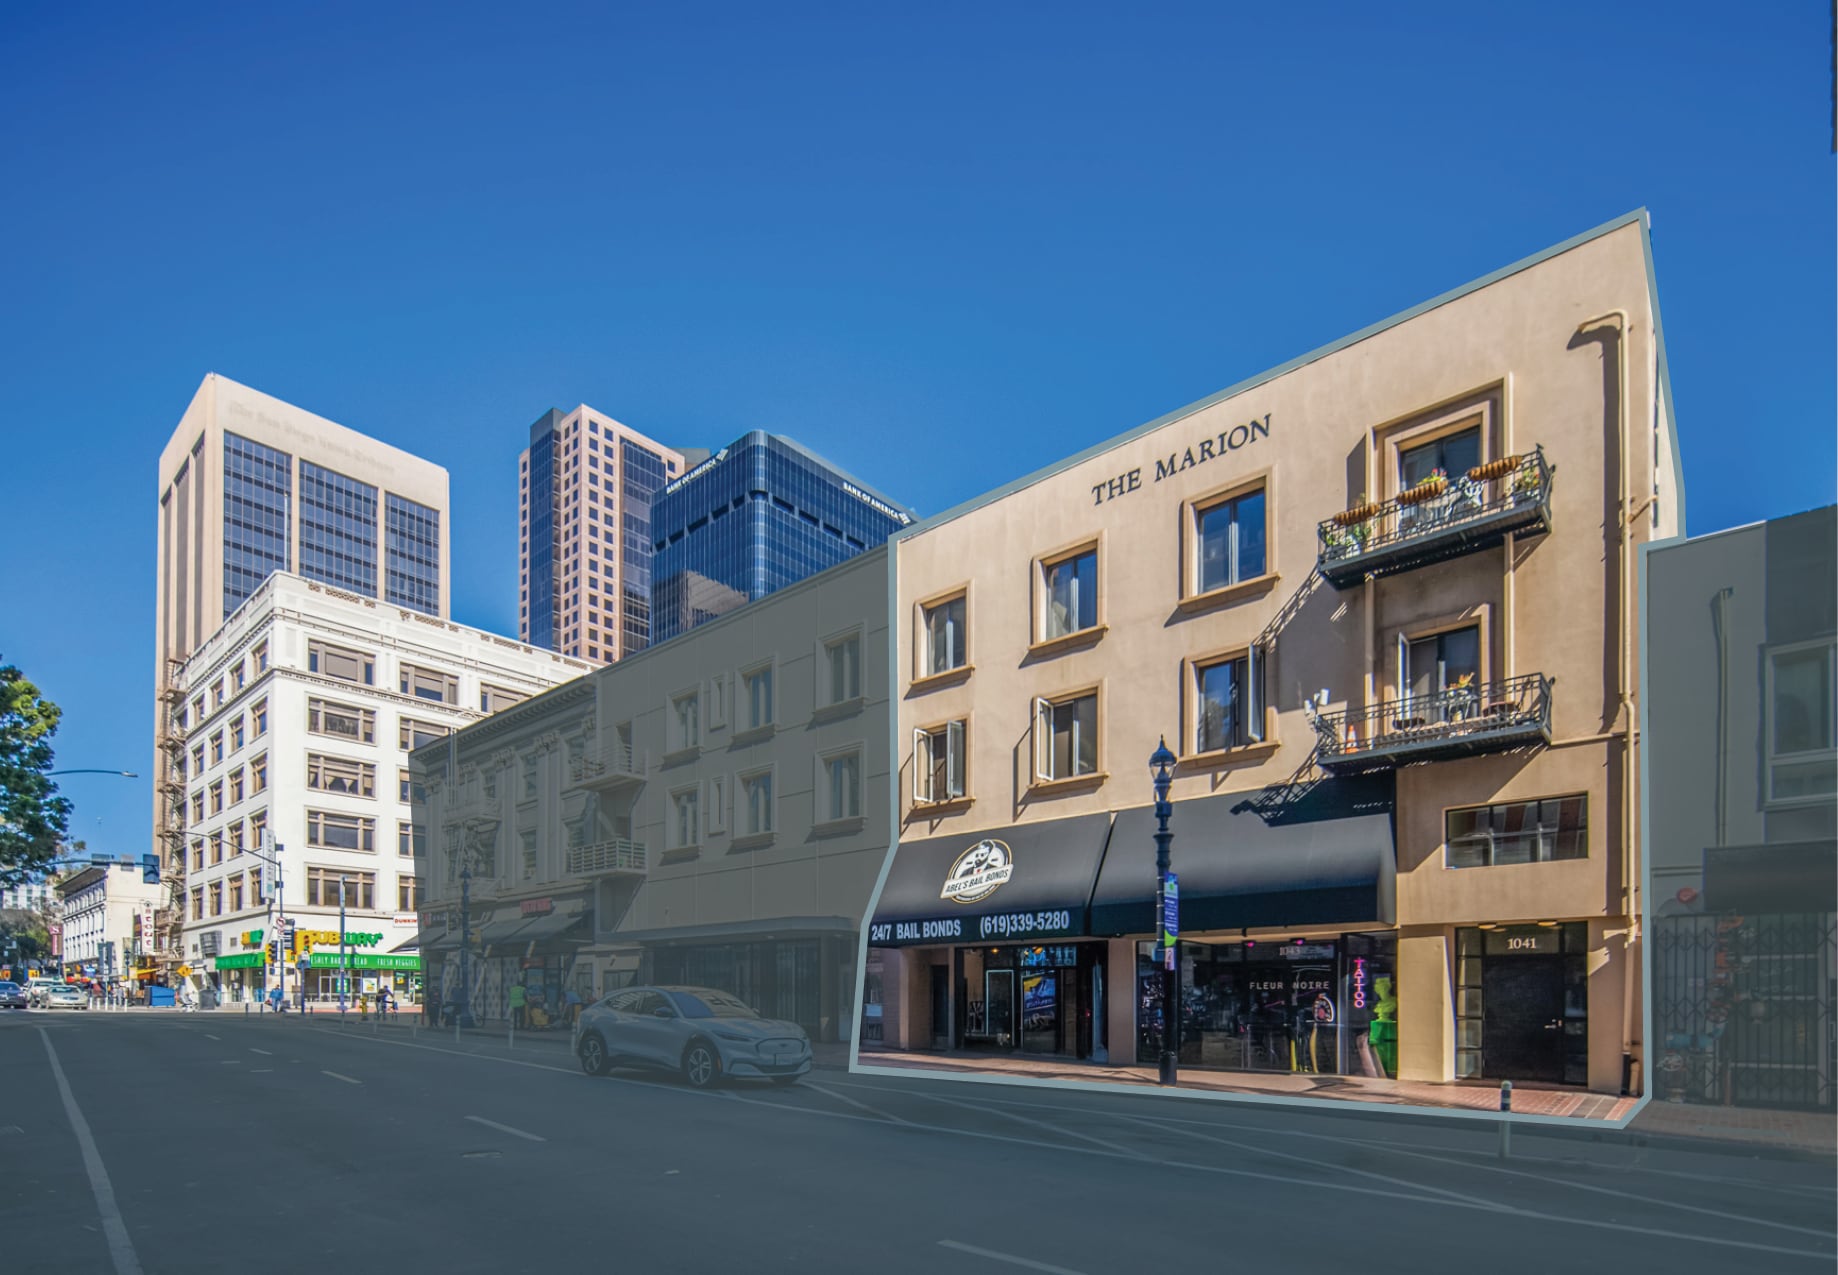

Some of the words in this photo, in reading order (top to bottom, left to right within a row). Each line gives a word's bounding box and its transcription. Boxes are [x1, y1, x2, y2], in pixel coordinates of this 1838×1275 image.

[1091, 467, 1142, 506] THE
[1154, 413, 1272, 482] MARION
[843, 481, 862, 498] BANK
[862, 493, 871, 504] OF
[871, 498, 899, 520] AMERICA
[944, 880, 969, 893] ABEL'S
[969, 876, 984, 888] BAIL
[985, 869, 1009, 882] BONDS
[871, 924, 892, 941] 24/7
[896, 921, 920, 939] BAIL
[923, 919, 961, 937] BONDS
[980, 910, 1070, 938] (619)339-5280
[1507, 937, 1537, 950] 1041
[1249, 981, 1284, 990] FLEUR
[1292, 980, 1329, 990] NOIRE
[1354, 956, 1367, 1009] TATTOO
